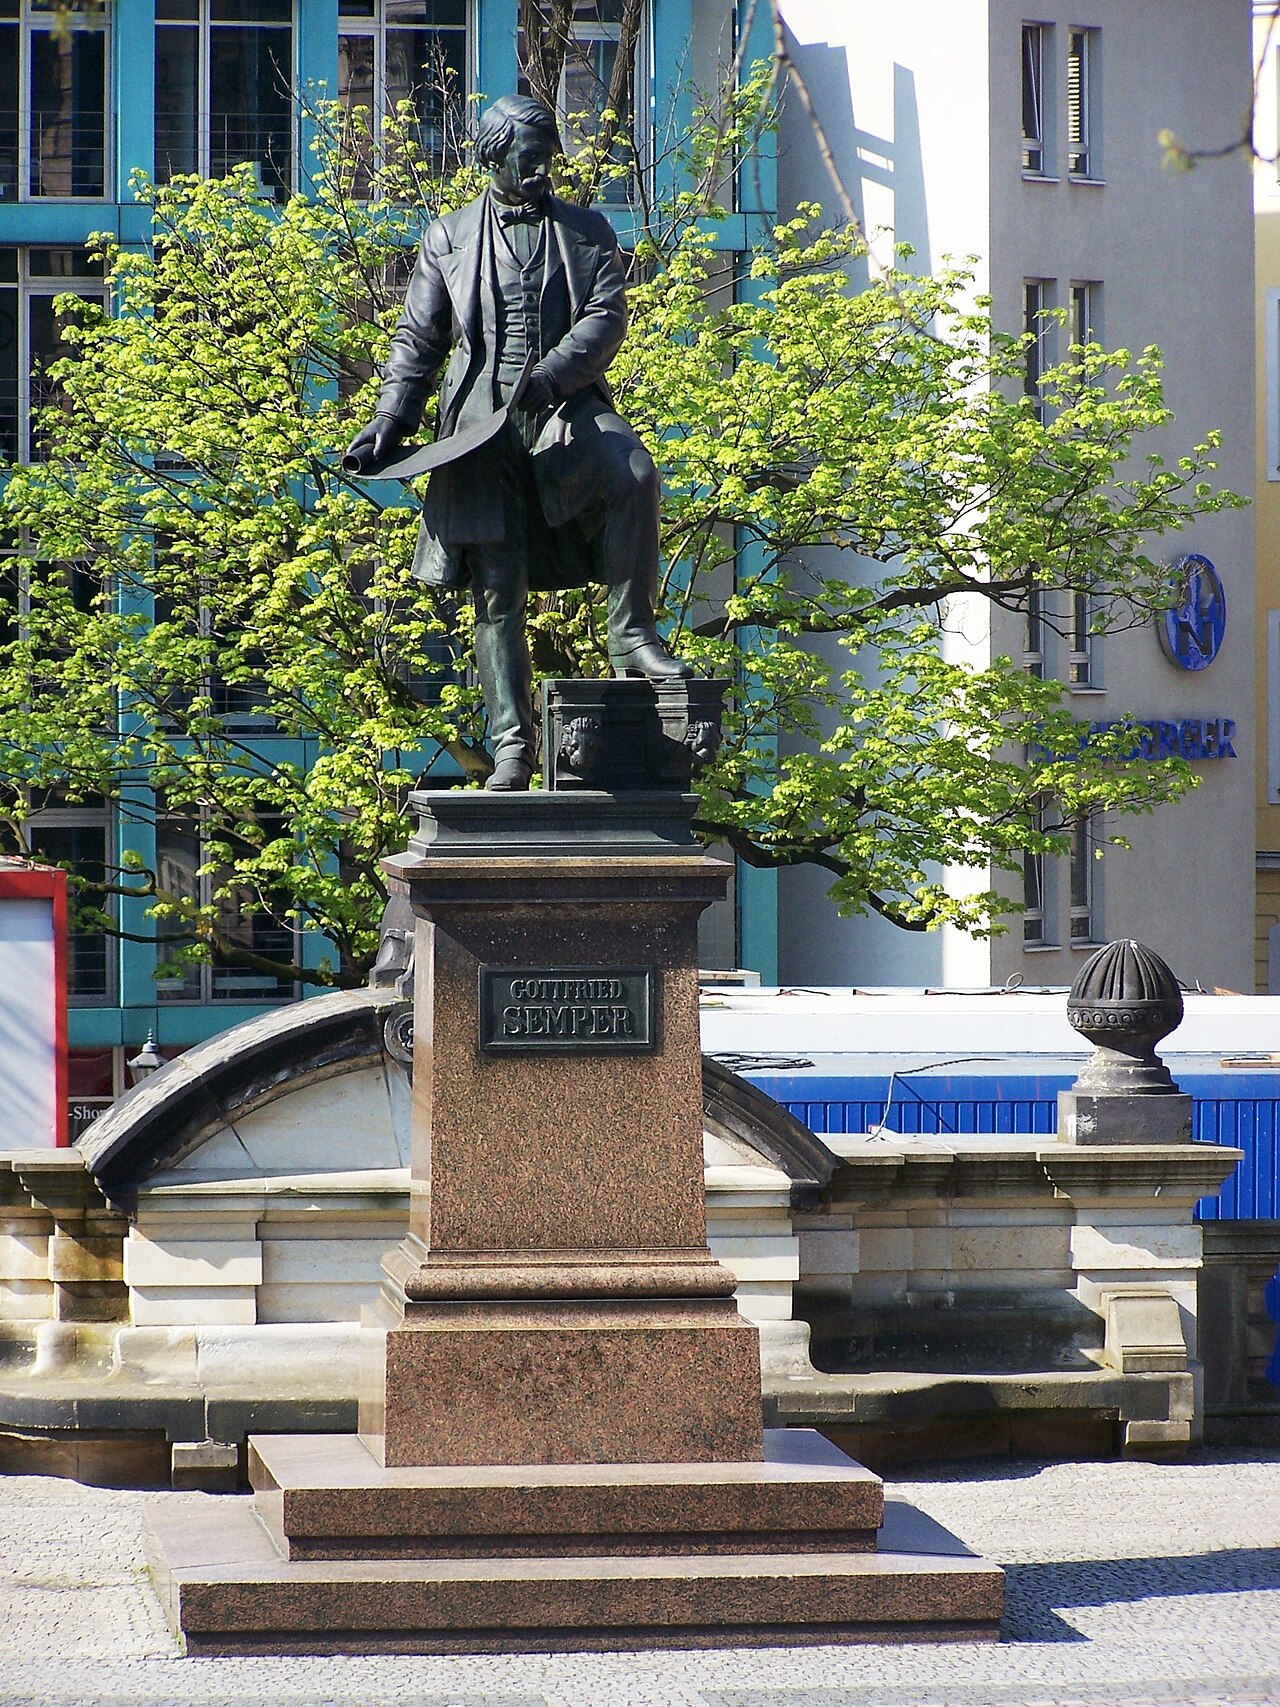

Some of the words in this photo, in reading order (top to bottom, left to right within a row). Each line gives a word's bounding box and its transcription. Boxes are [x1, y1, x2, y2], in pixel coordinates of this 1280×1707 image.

[1034, 718, 1238, 762] ERGER
[509, 979, 624, 999] GOTTFRIED
[503, 1005, 633, 1034] SEMPER
